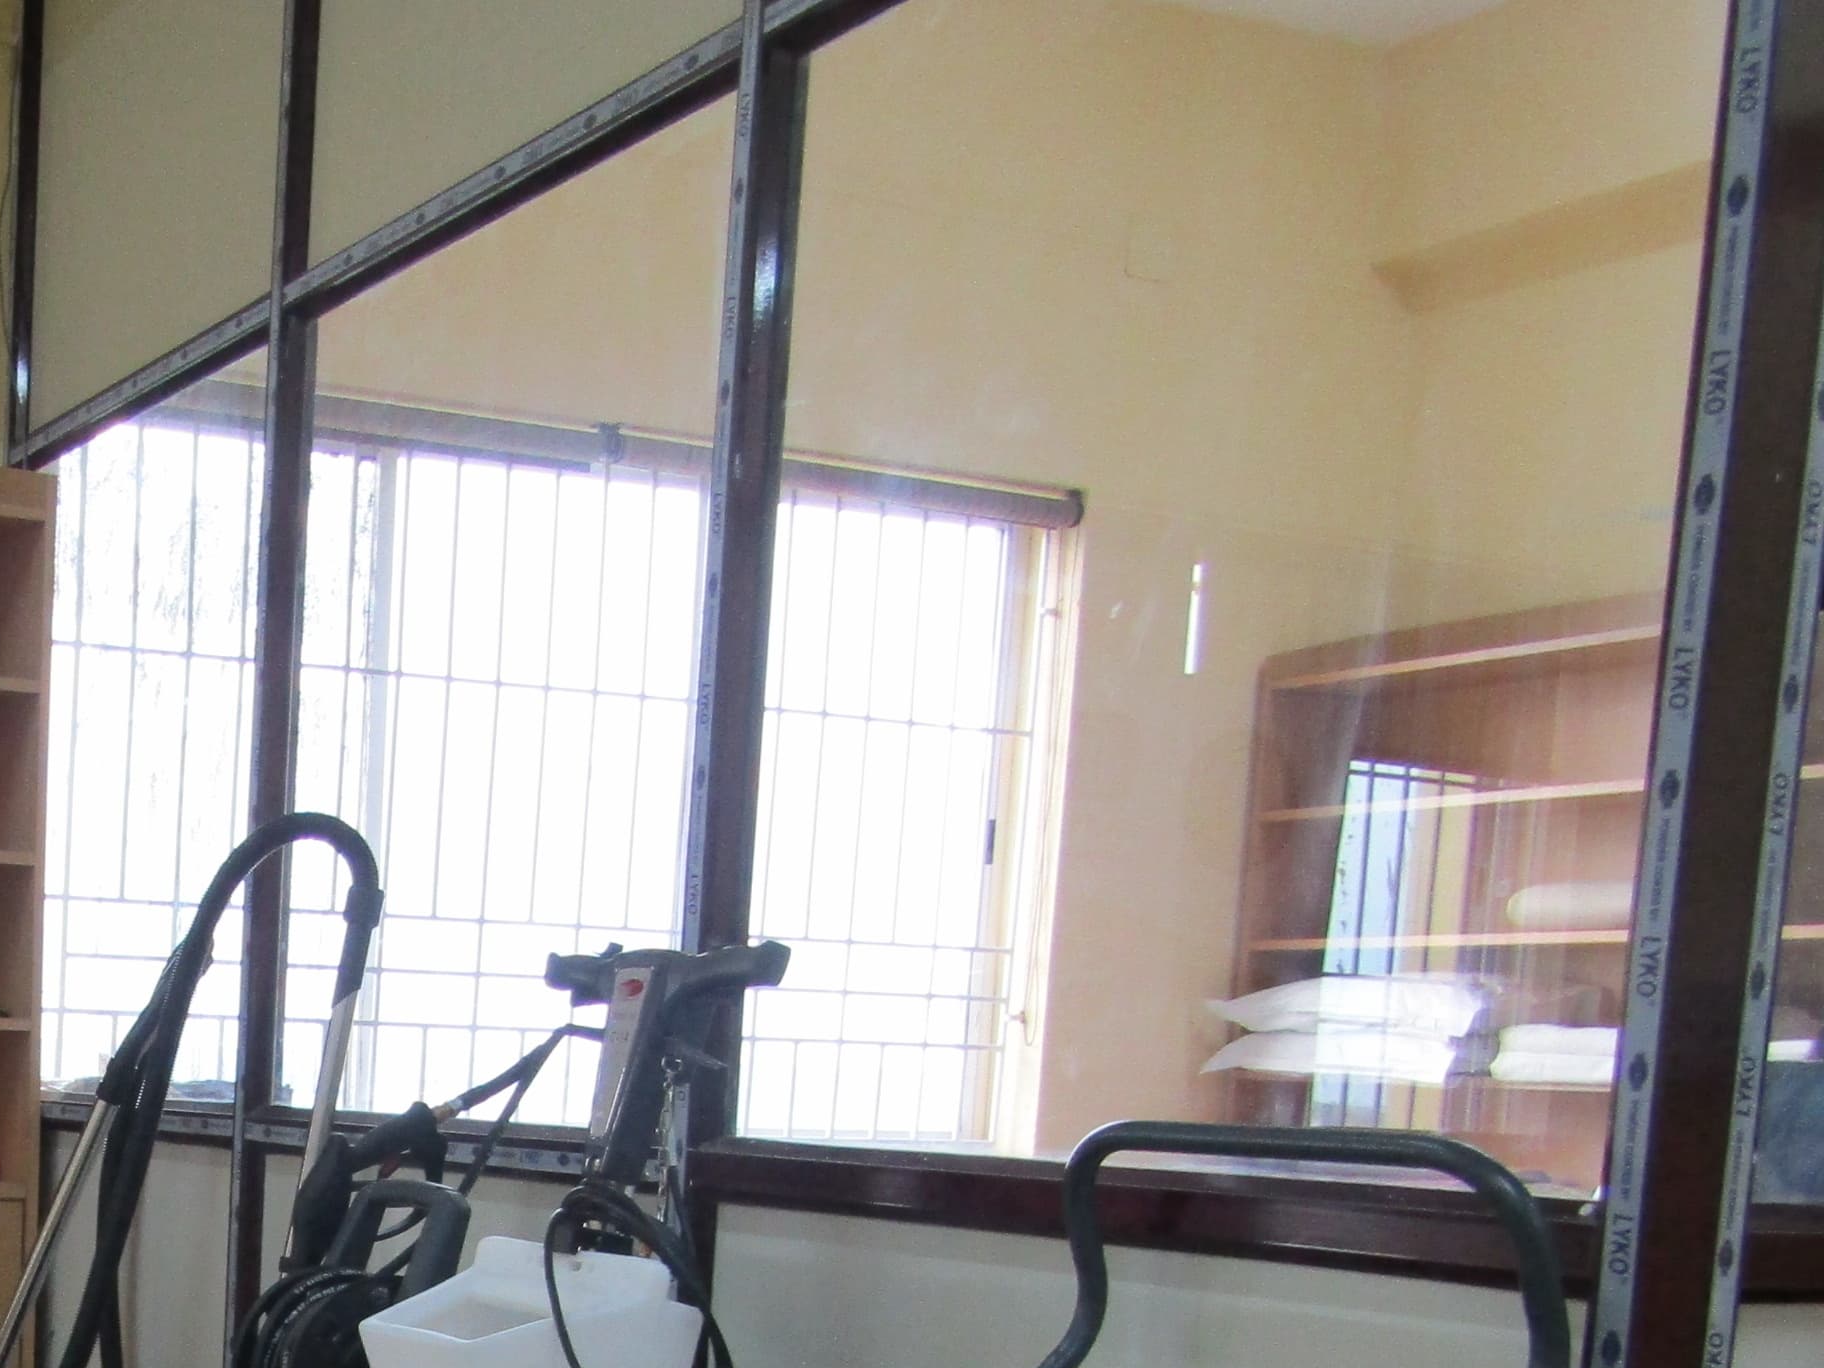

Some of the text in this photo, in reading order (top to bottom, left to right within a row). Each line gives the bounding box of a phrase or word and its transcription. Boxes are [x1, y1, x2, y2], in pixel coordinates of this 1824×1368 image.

[1703, 351, 1730, 416] LYKO
[1668, 647, 1694, 710] LYKO
[1636, 936, 1661, 998] LYKO
[1609, 1214, 1633, 1275] LYKO
